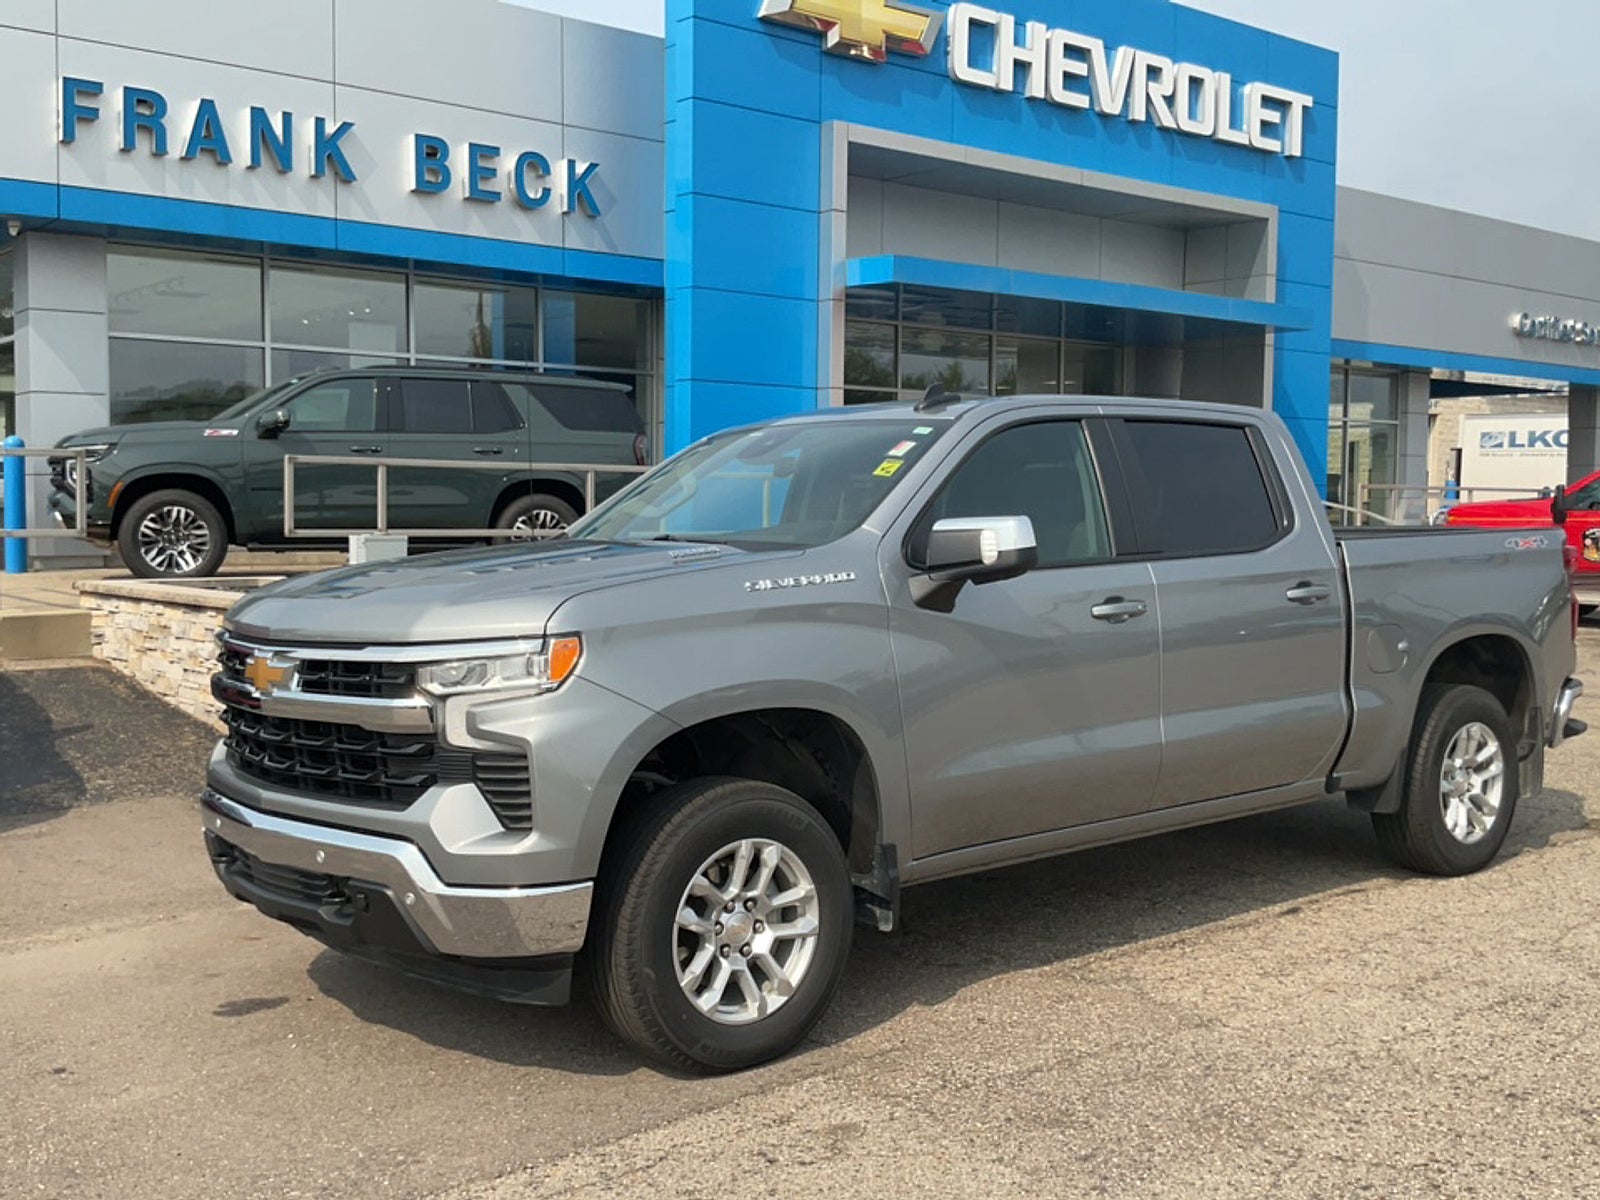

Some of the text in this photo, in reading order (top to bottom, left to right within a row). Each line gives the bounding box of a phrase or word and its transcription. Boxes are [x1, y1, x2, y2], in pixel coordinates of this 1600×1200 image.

[58, 76, 601, 217] FRANK BECK
[947, 2, 1312, 157] CHEVROLET
